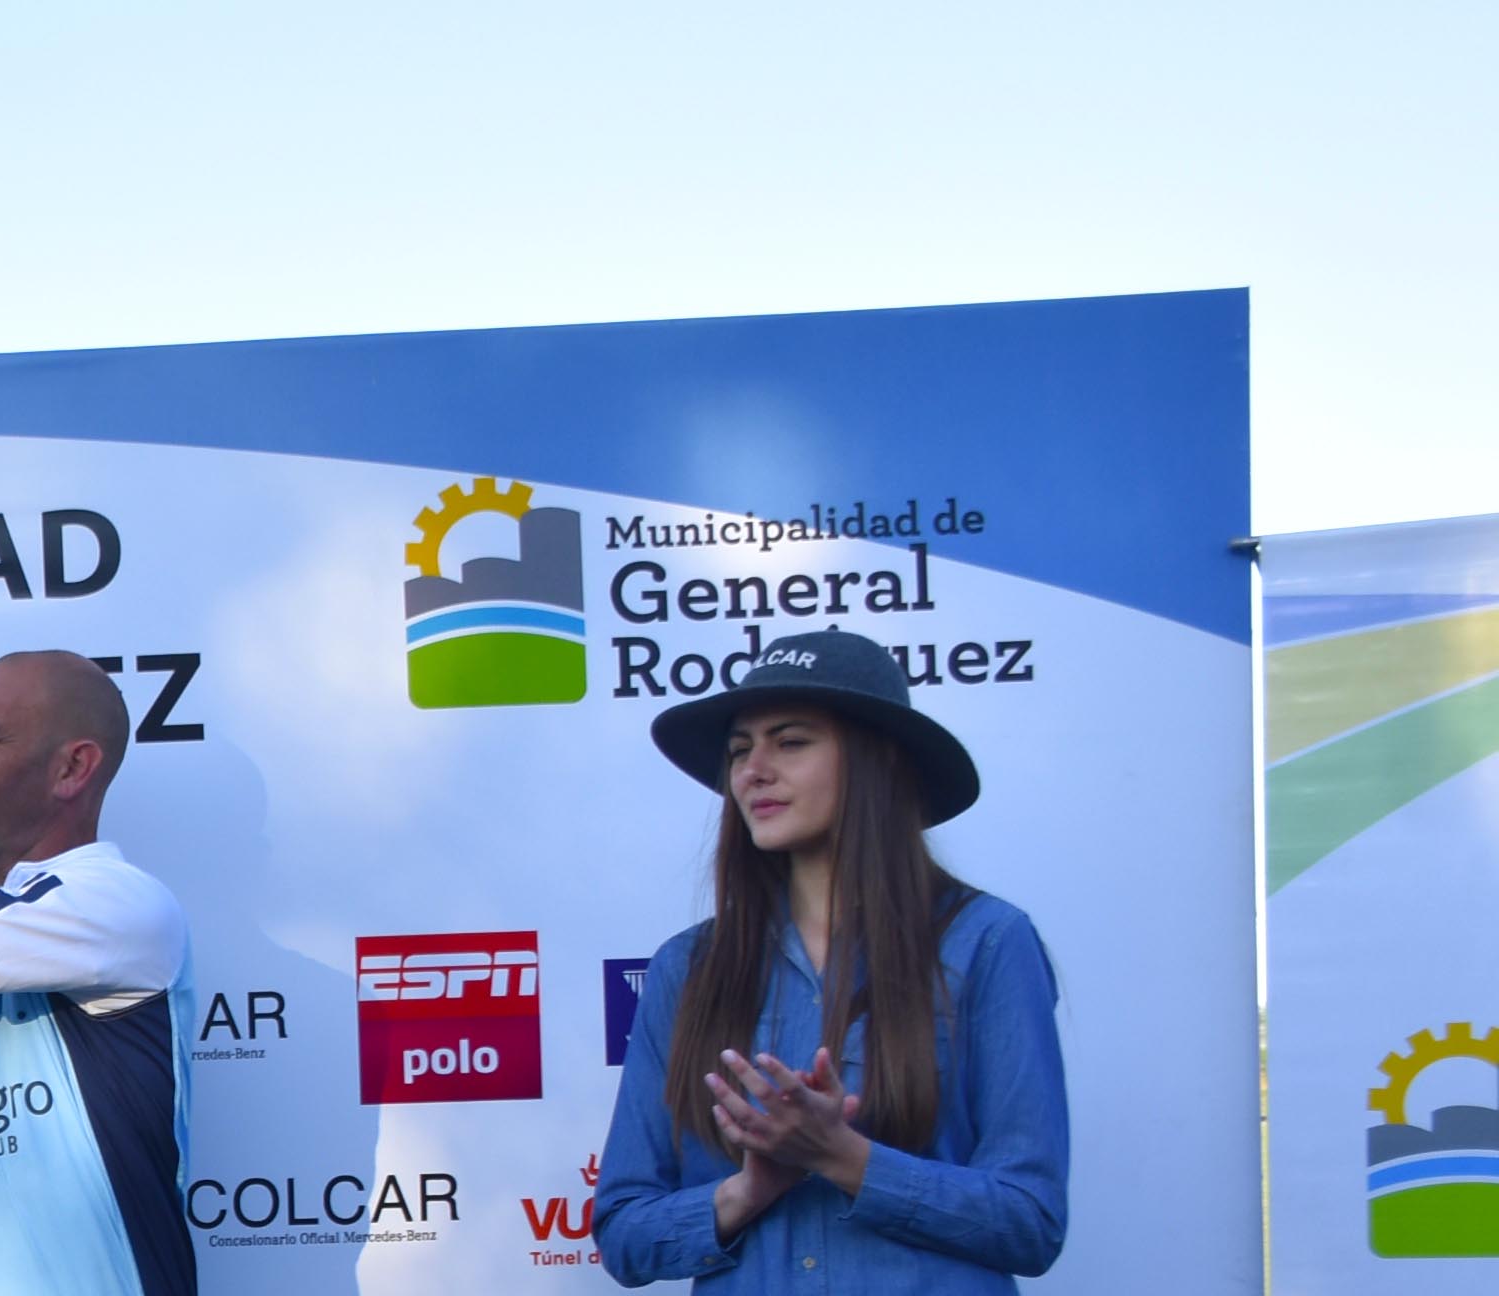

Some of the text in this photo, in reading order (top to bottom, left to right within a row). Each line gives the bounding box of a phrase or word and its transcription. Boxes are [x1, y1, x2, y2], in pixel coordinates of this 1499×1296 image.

[606, 499, 985, 553] Municipalidad de
[611, 544, 936, 625] General
[613, 624, 1034, 699] Roduez
[358, 950, 538, 1001] ESPN
[191, 1047, 266, 1060] rcedes-Benz
[403, 1039, 499, 1084] polo
[186, 1172, 460, 1230] COLCAR
[209, 1229, 437, 1248] Concesionario Oficial Mercedes-Benz
[530, 1249, 582, 1267] Túnel
